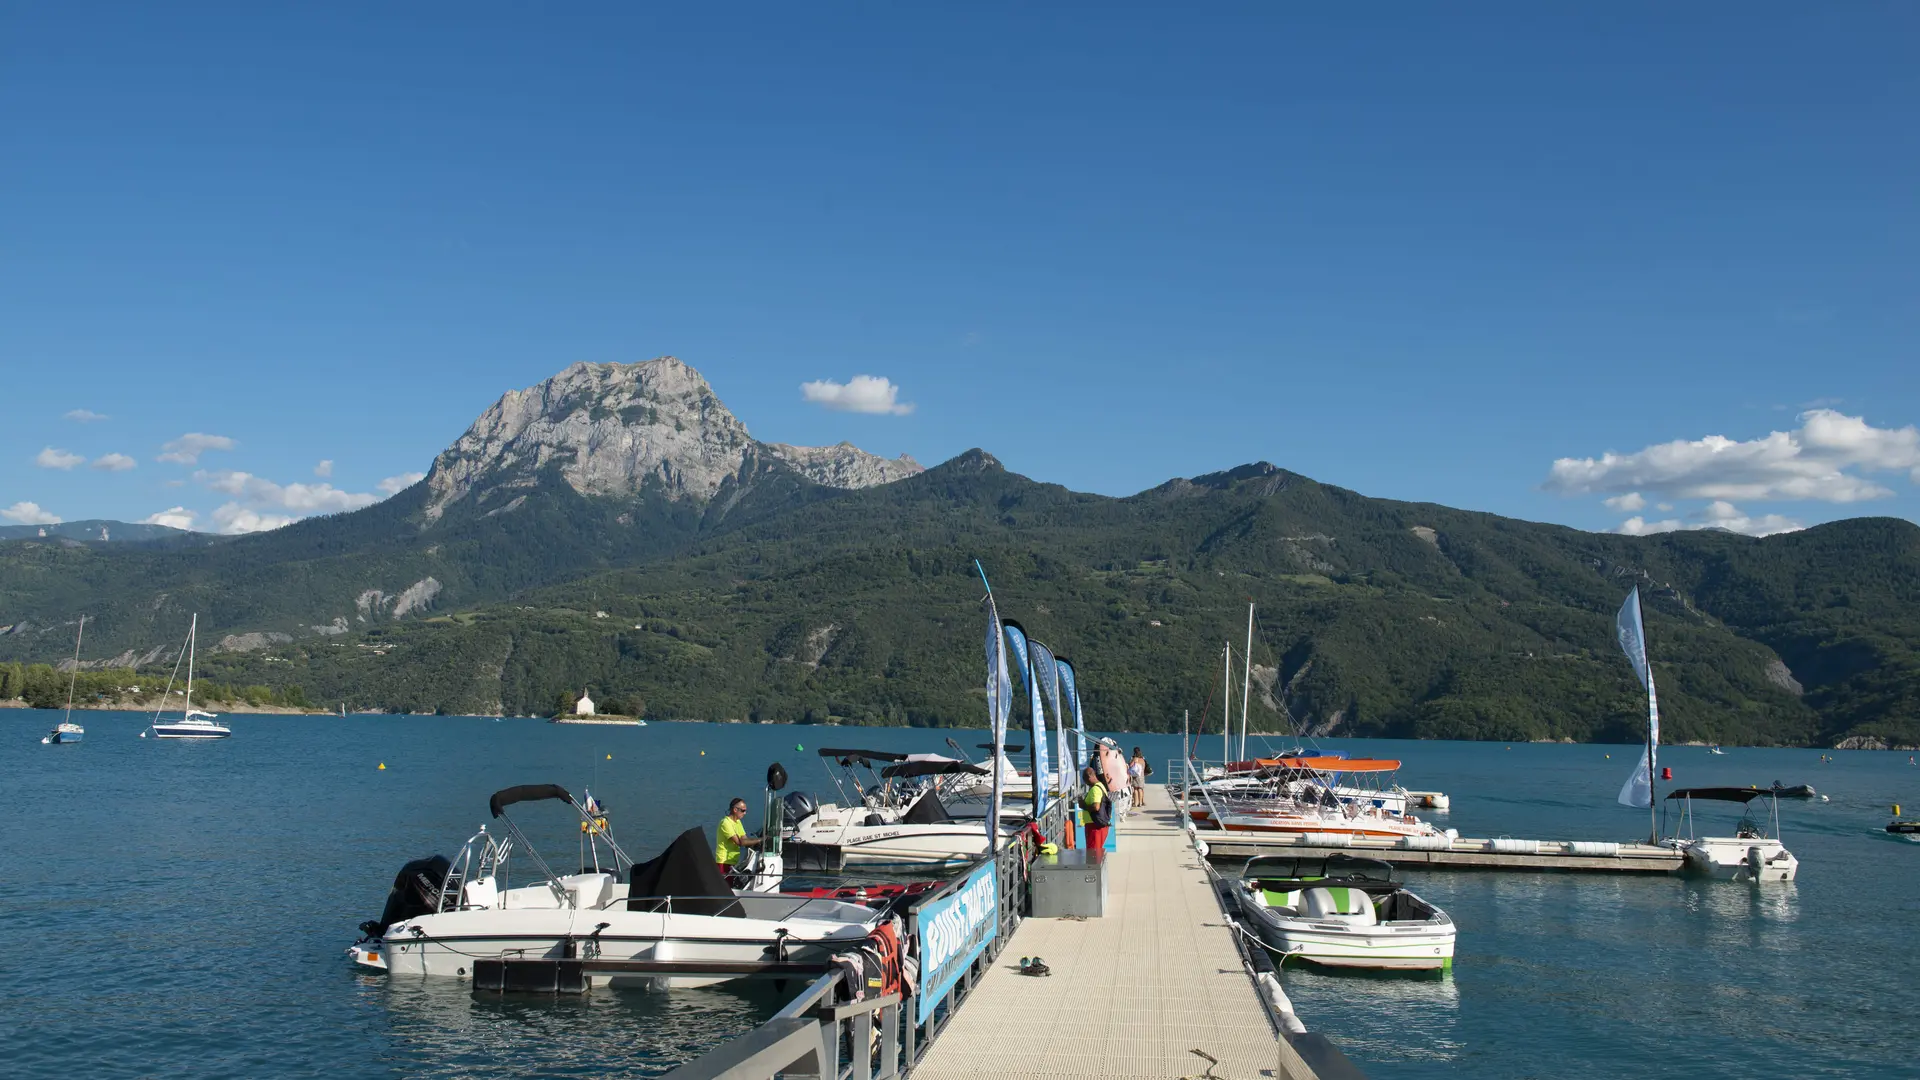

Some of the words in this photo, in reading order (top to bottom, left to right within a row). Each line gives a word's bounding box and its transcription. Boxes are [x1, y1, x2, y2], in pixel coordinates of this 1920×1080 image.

[846, 836, 861, 844] PLAGE
[883, 830, 900, 838] MICHEL
[769, 863, 776, 877] 2
